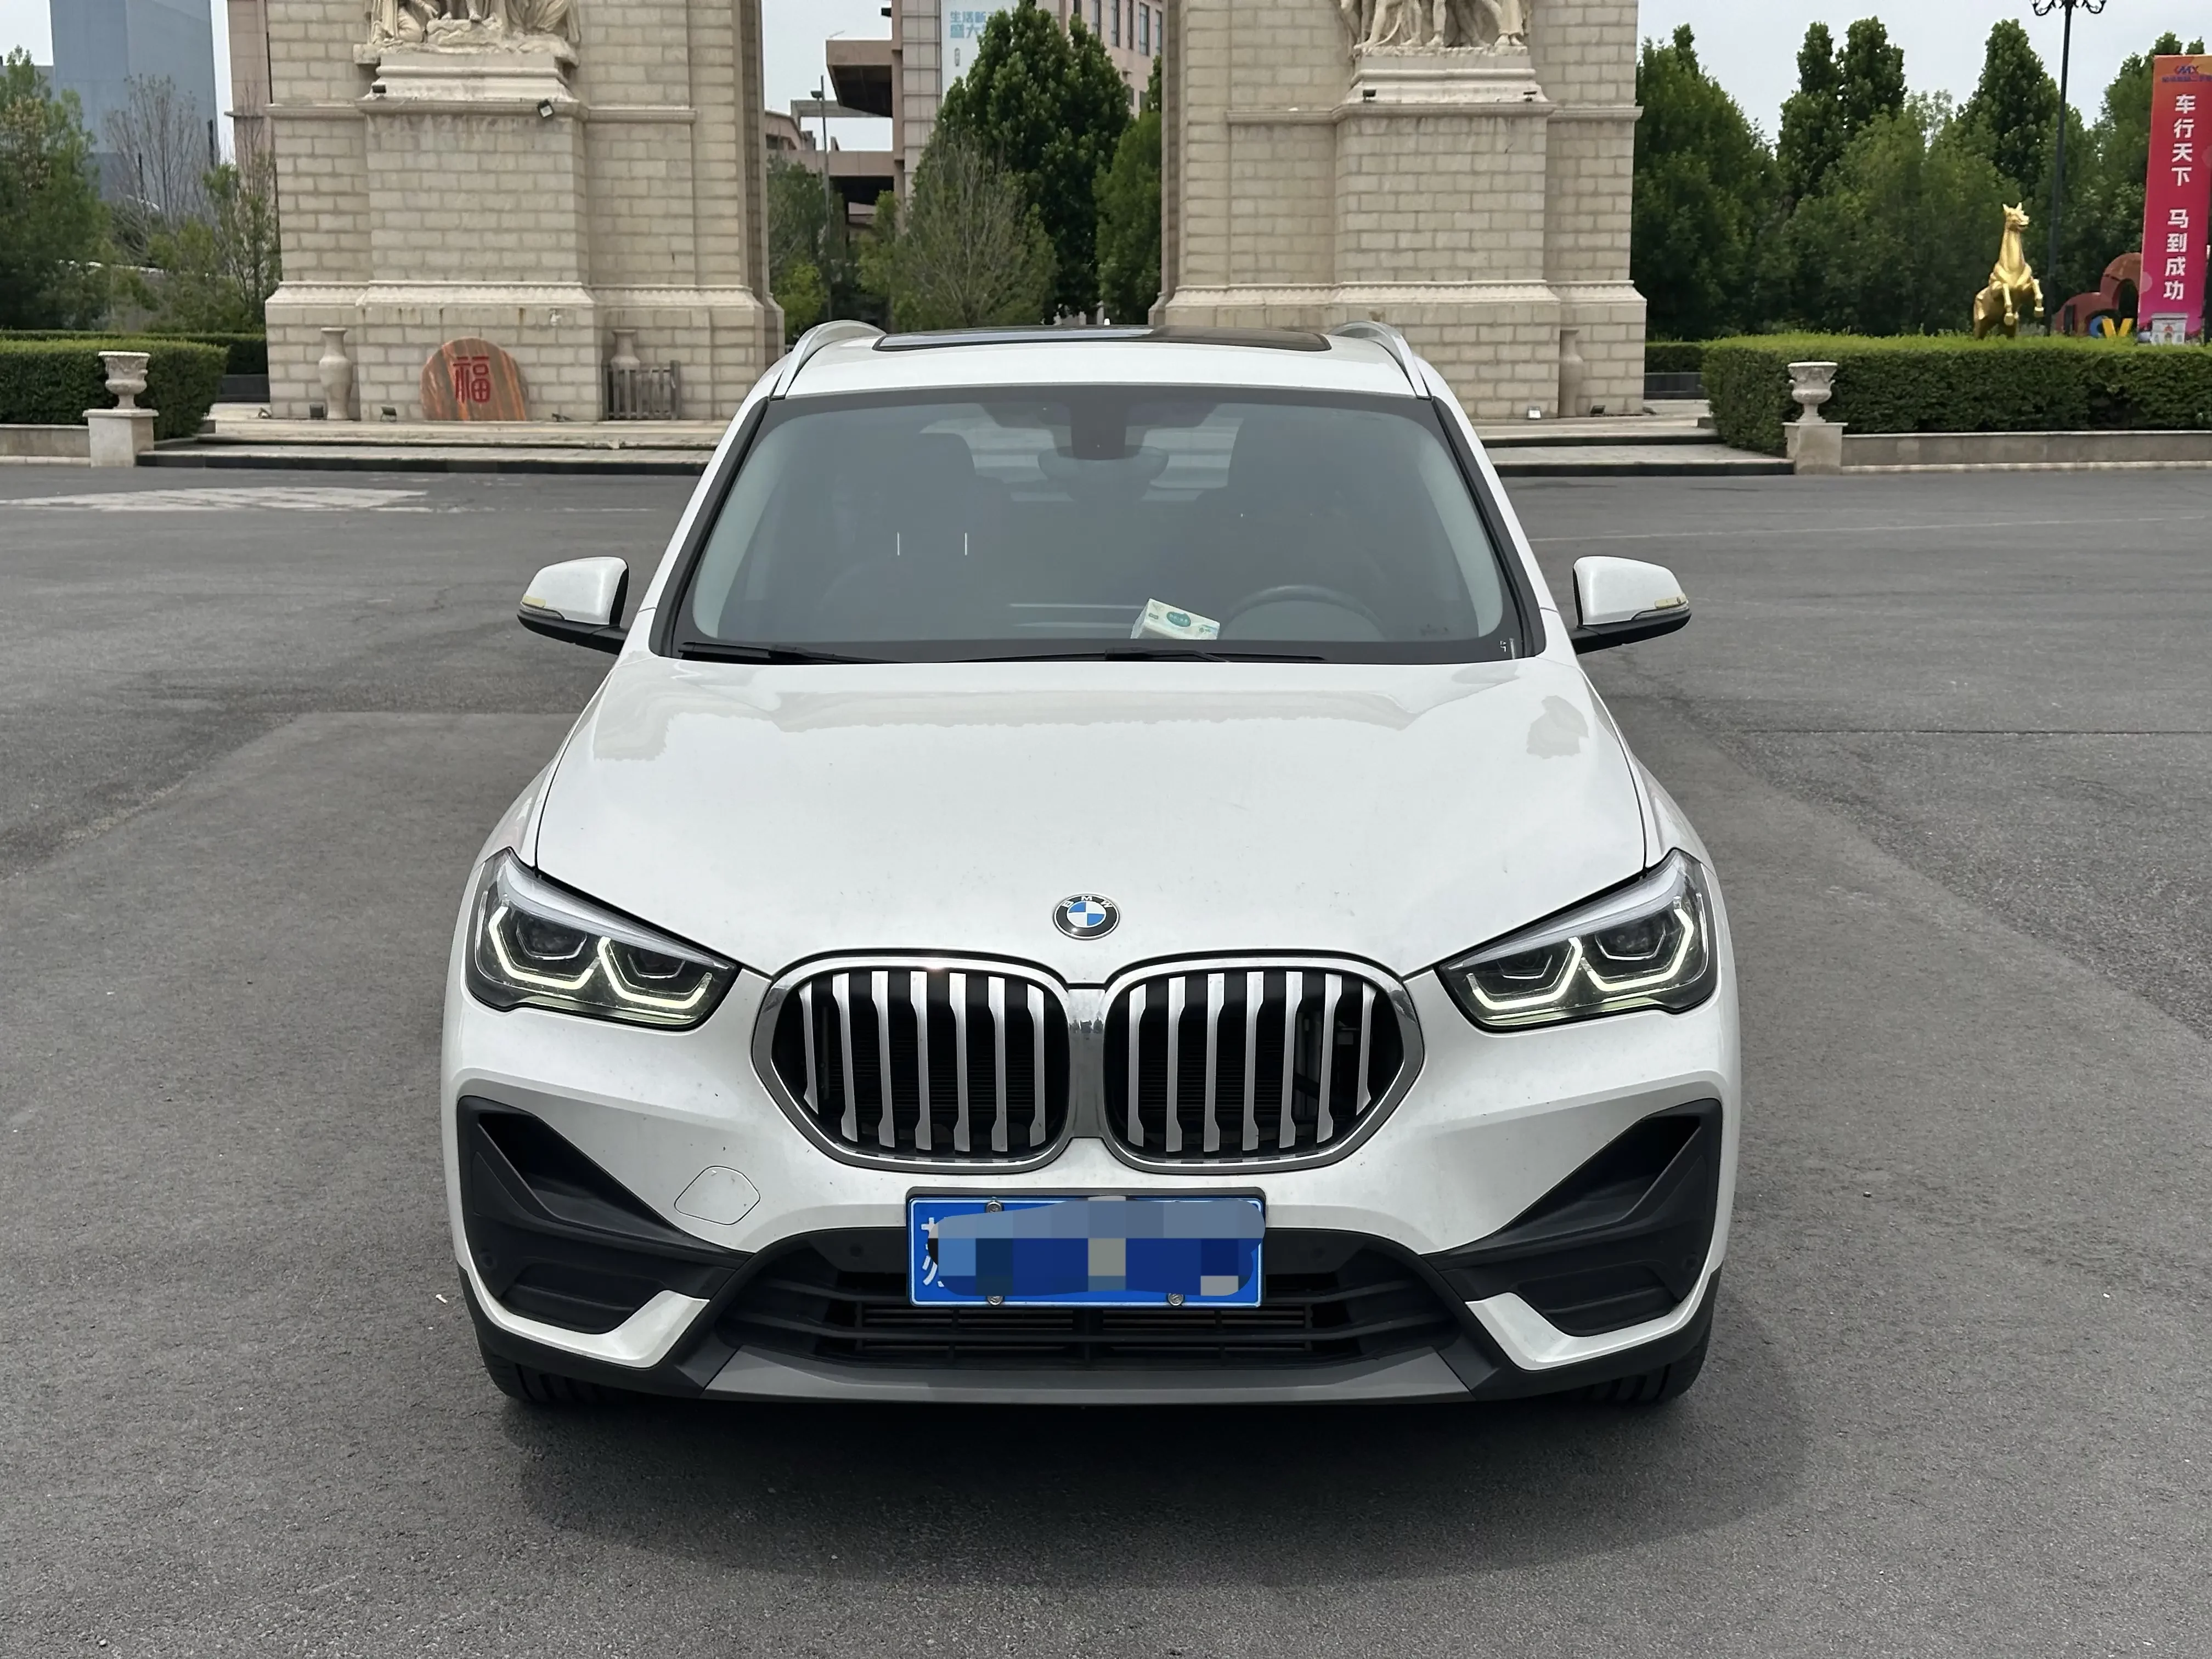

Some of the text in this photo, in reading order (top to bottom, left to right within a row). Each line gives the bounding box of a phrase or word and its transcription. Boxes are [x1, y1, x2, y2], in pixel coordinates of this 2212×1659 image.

[2171, 94, 2196, 187] 车行天下
[2163, 208, 2189, 301] 马到成功
[453, 356, 490, 404] 福
[1061, 895, 1113, 909] BMW
